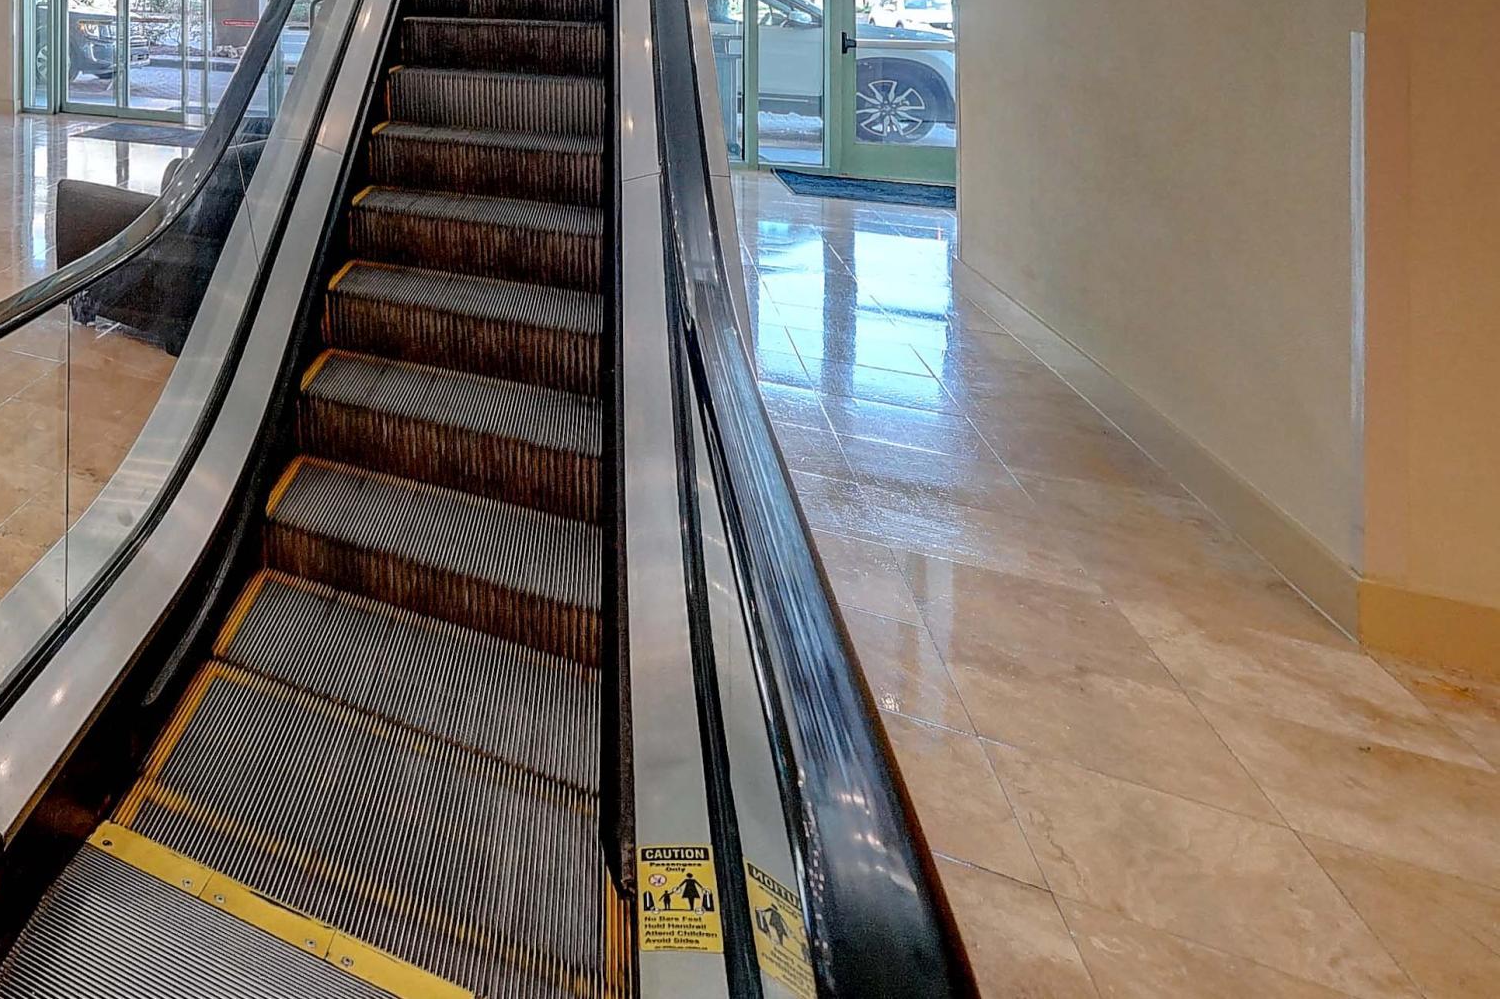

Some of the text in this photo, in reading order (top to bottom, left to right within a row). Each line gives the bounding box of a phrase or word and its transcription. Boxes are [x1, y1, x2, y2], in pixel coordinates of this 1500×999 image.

[645, 849, 704, 859] CAUTION
[677, 930, 718, 938] Children
[644, 937, 671, 945] Avoid
